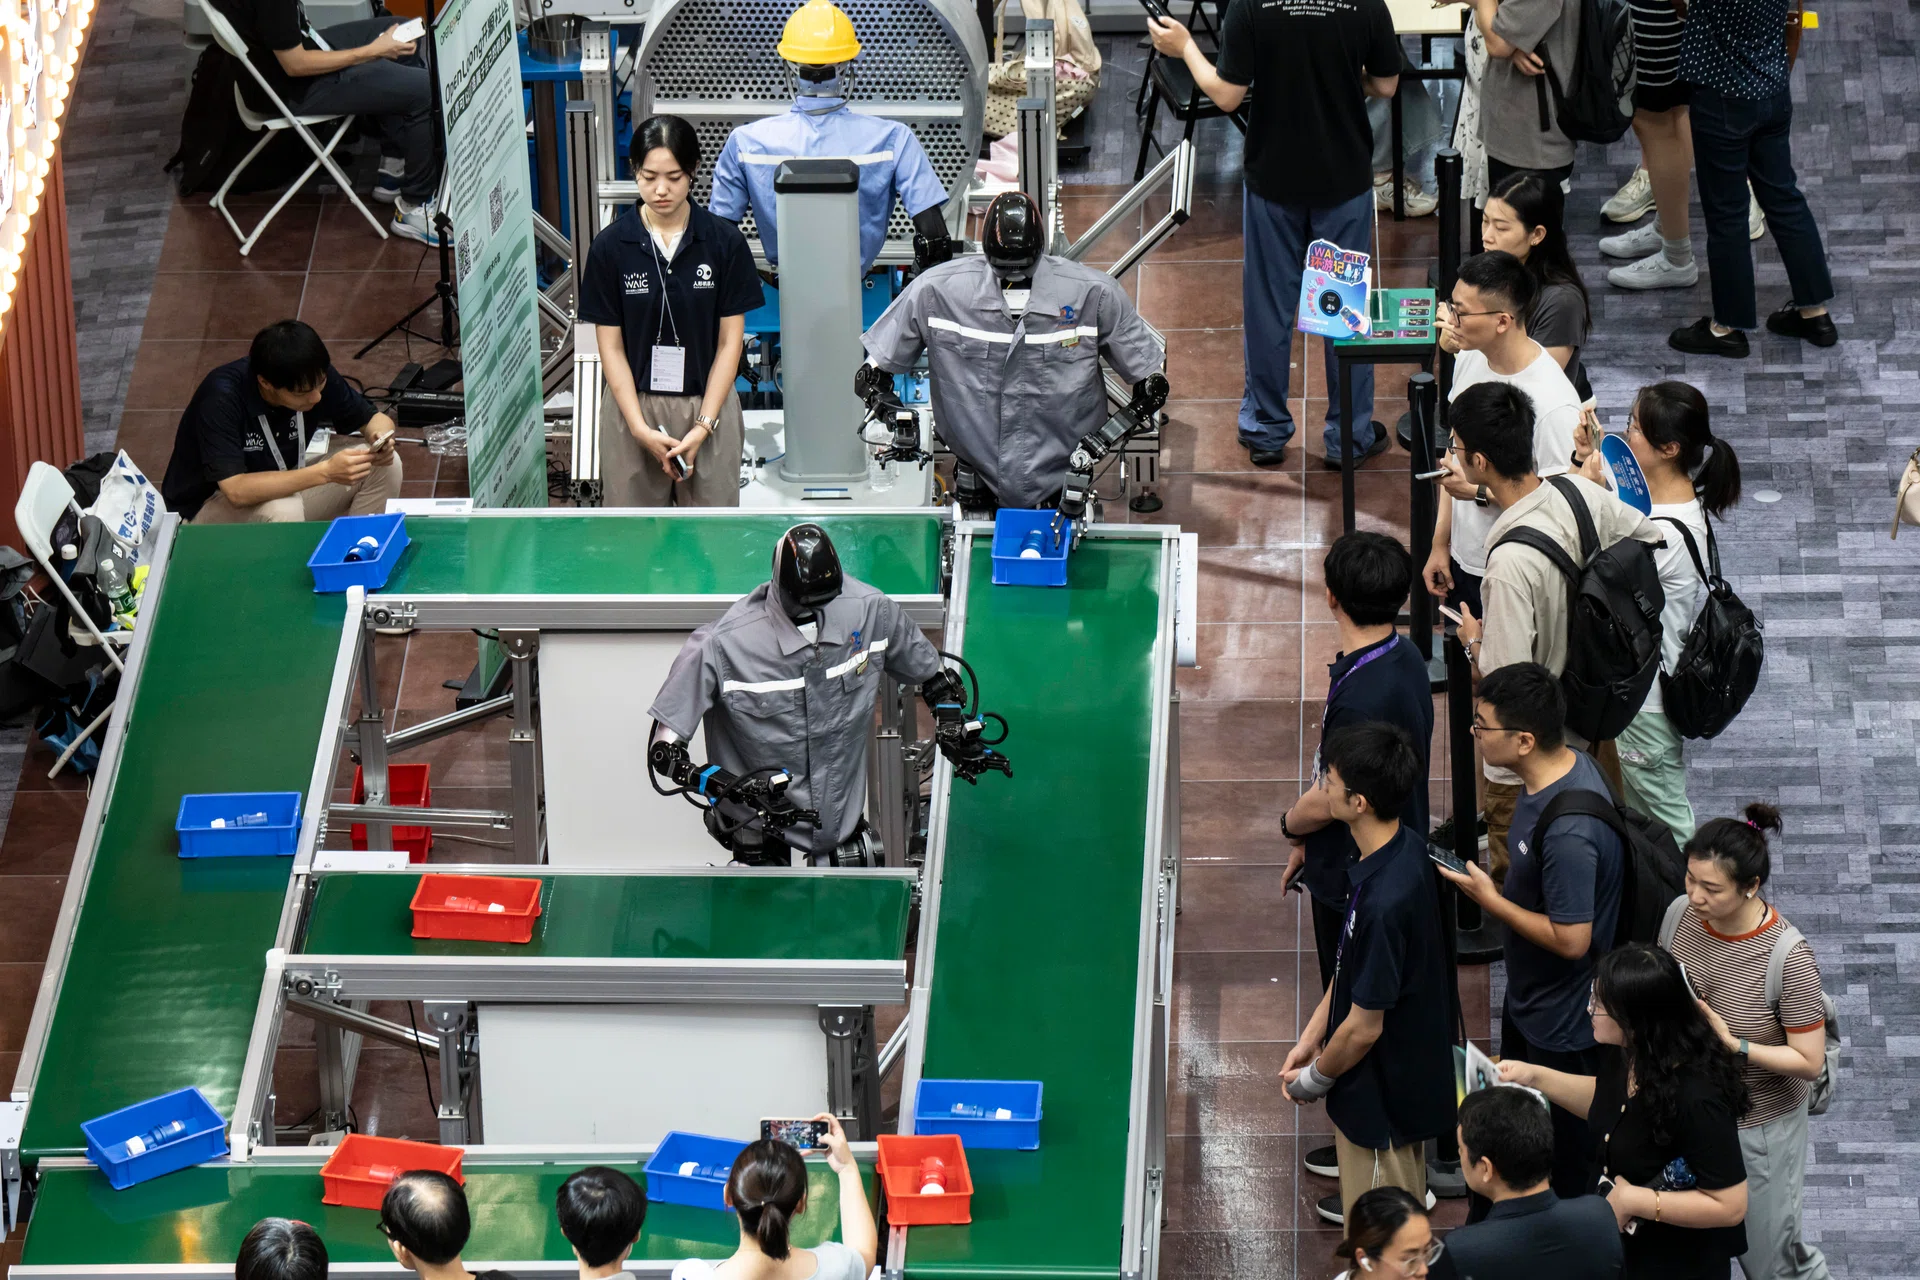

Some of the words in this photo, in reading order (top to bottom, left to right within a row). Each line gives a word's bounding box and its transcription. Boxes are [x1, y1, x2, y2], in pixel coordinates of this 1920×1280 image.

[1313, 246, 1342, 261] WAIC
[1343, 251, 1367, 266] CITY
[1309, 256, 1345, 274] 环游记
[624, 279, 649, 289] WAIC
[245, 438, 265, 447] WAIC
